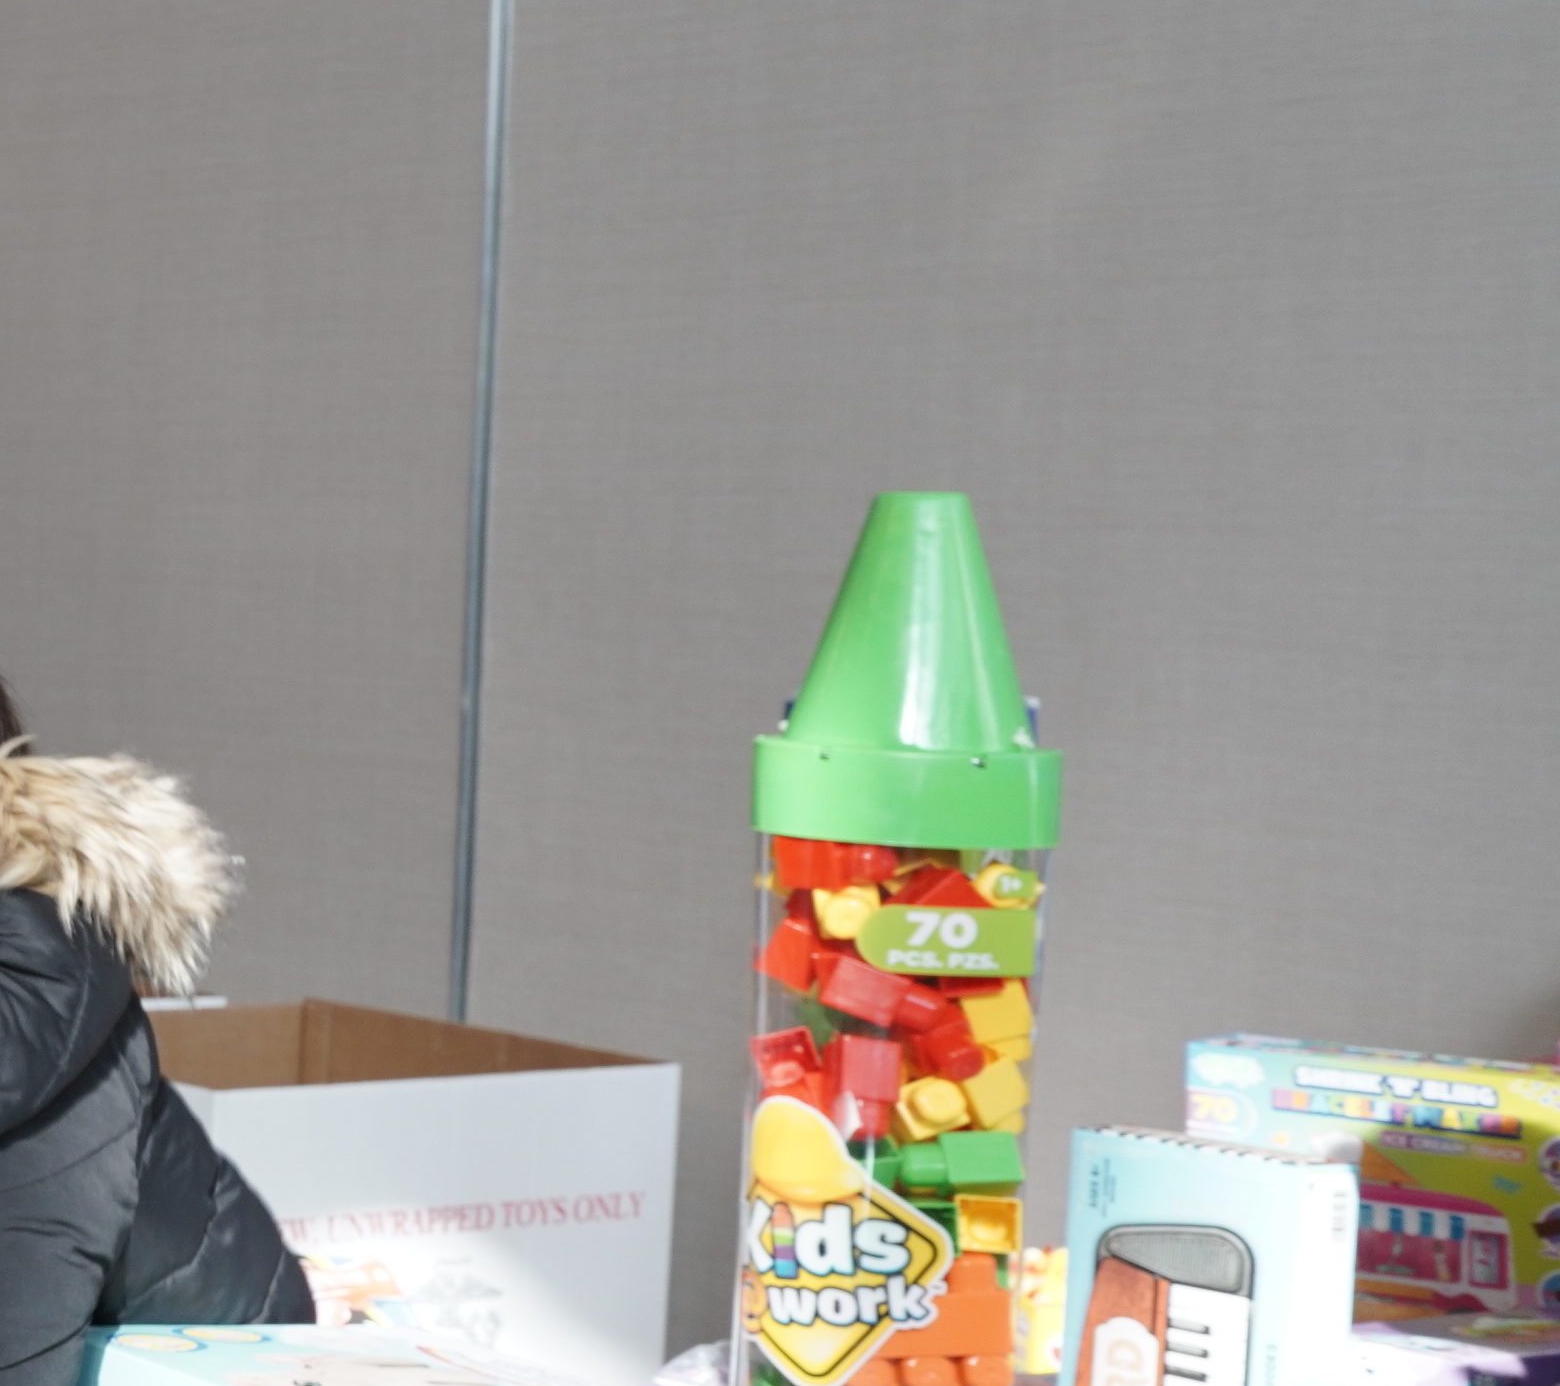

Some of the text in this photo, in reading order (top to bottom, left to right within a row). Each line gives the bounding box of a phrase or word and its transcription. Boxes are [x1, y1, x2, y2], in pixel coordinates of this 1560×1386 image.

[905, 912, 978, 949] 70
[887, 950, 944, 969] PCS.
[501, 1196, 568, 1230] TOYS
[573, 1191, 647, 1224] ONLY
[767, 1276, 932, 1326] work
